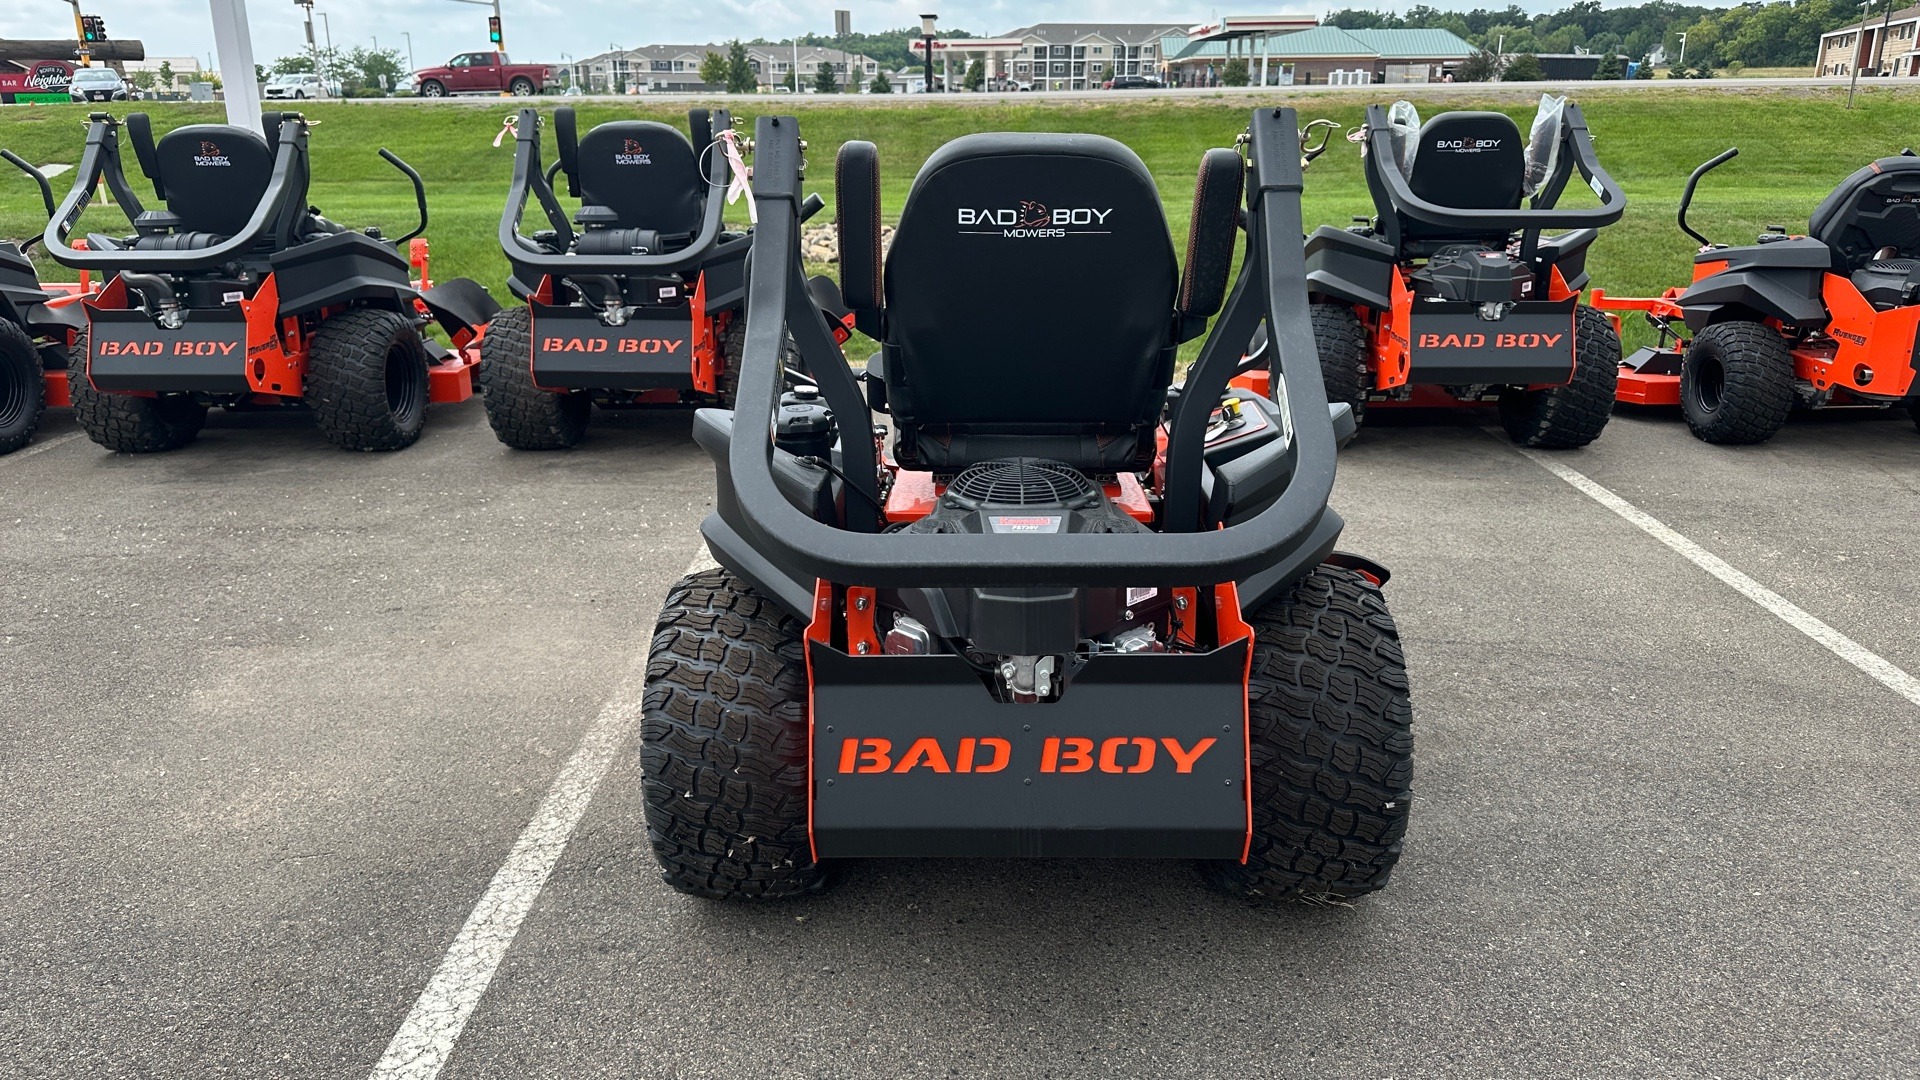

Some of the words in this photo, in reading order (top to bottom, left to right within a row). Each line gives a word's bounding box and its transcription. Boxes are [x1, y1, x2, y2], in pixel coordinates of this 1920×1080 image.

[1437, 140, 1462, 148] BAD
[1476, 139, 1501, 147] BOY
[958, 208, 1017, 225] BAD
[1052, 208, 1113, 225] BOY
[1003, 228, 1065, 238] MOWERS
[542, 337, 608, 352] BAD
[617, 338, 683, 354] BOY
[1418, 333, 1486, 348] BAD
[1495, 333, 1563, 348] BOY
[99, 341, 164, 356] BAD
[173, 341, 238, 356] BOY
[837, 737, 1012, 774] BAD
[1039, 736, 1219, 774] BOY
